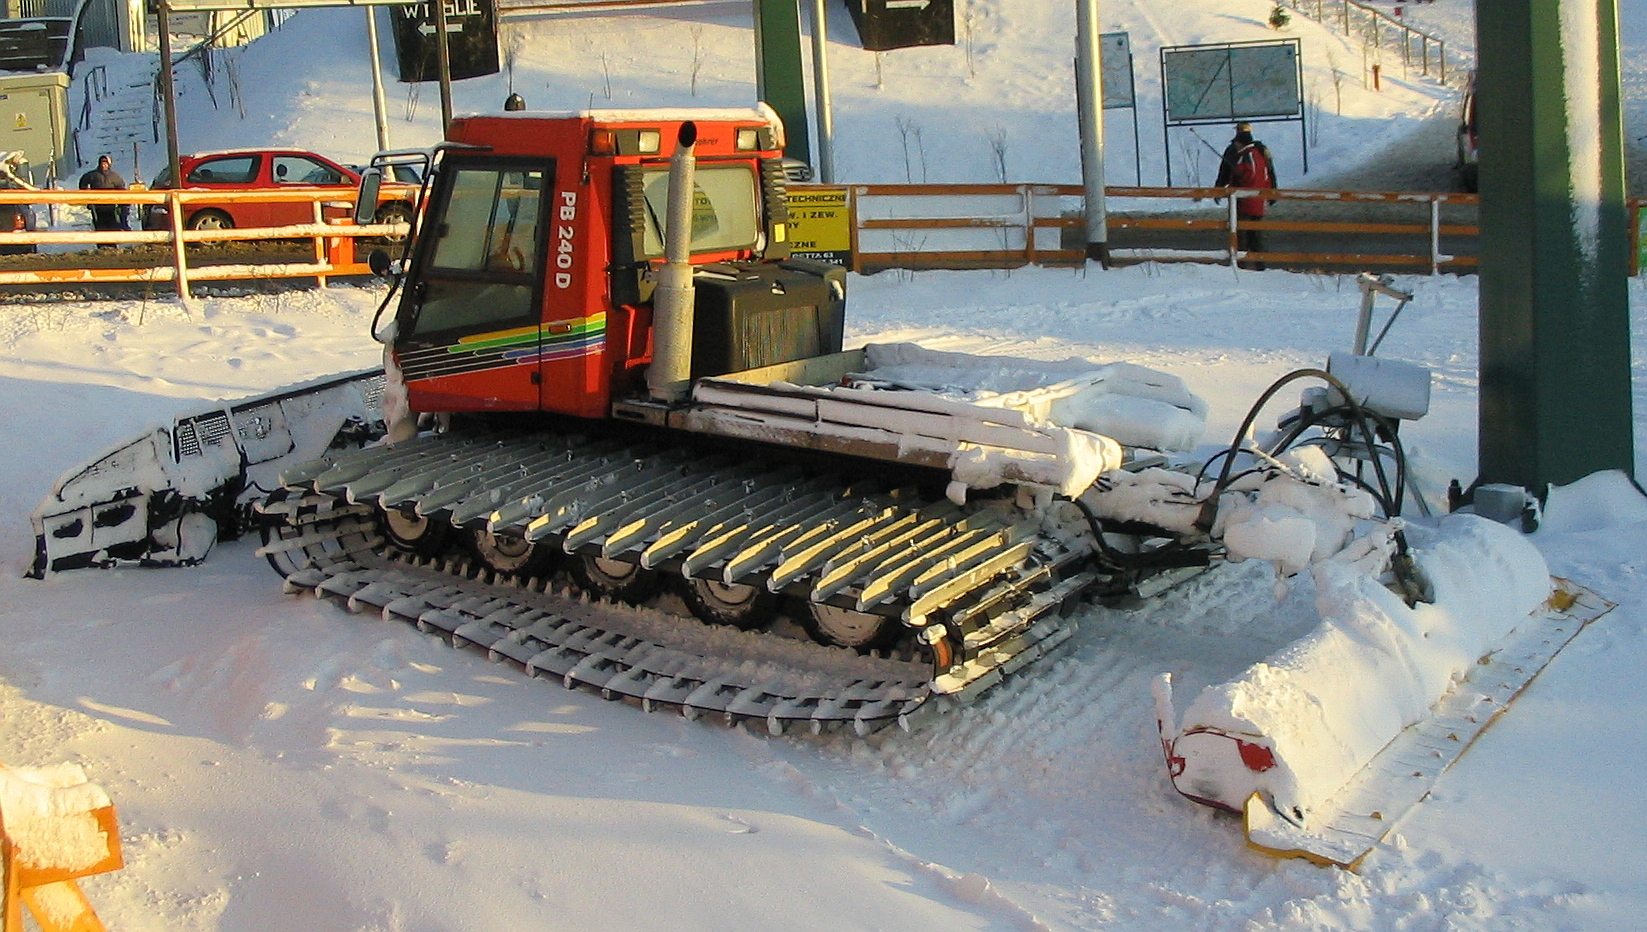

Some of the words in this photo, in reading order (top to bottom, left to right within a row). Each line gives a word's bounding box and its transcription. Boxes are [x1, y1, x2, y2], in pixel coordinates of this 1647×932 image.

[560, 191, 577, 221] PB
[787, 194, 846, 203] TECHNICZN
[557, 225, 574, 269] 240
[555, 272, 571, 289] D
